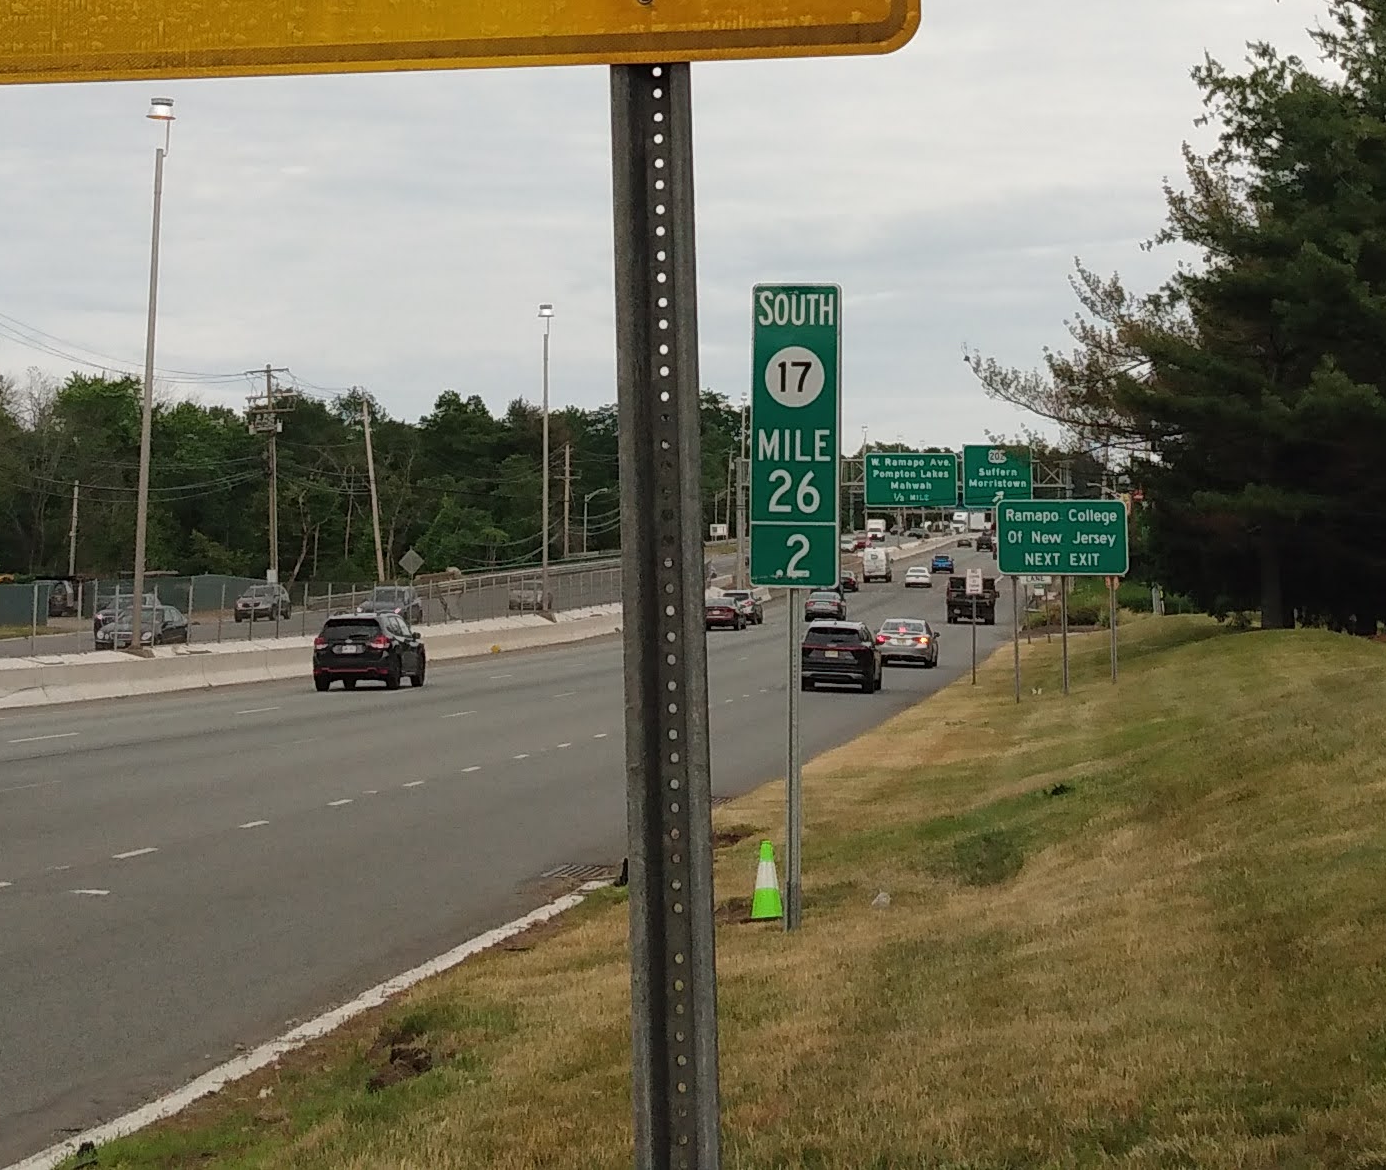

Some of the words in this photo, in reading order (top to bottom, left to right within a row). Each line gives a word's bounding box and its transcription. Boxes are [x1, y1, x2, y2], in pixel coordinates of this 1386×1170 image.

[758, 291, 834, 326] SOUTH
[778, 361, 812, 392] 17
[758, 429, 831, 462] MILE
[885, 458, 925, 468] Ramapo
[930, 458, 952, 467] Ave.
[989, 452, 1005, 461] 202
[873, 470, 916, 479] Pompton
[920, 470, 949, 478] Lakes
[978, 468, 1018, 477] Suffern
[891, 481, 932, 490] Mahwah
[968, 479, 1027, 488] Morristown
[768, 469, 821, 514] 26
[910, 494, 930, 502] MILE
[1005, 509, 1059, 524] Ramapo
[1068, 509, 1118, 526] College
[1008, 530, 1023, 544] Of
[1031, 531, 1062, 544] New
[1072, 531, 1117, 548] Jersey
[775, 533, 810, 578] .2
[1024, 553, 1061, 566] NEXT
[1069, 553, 1101, 566] EXIT
